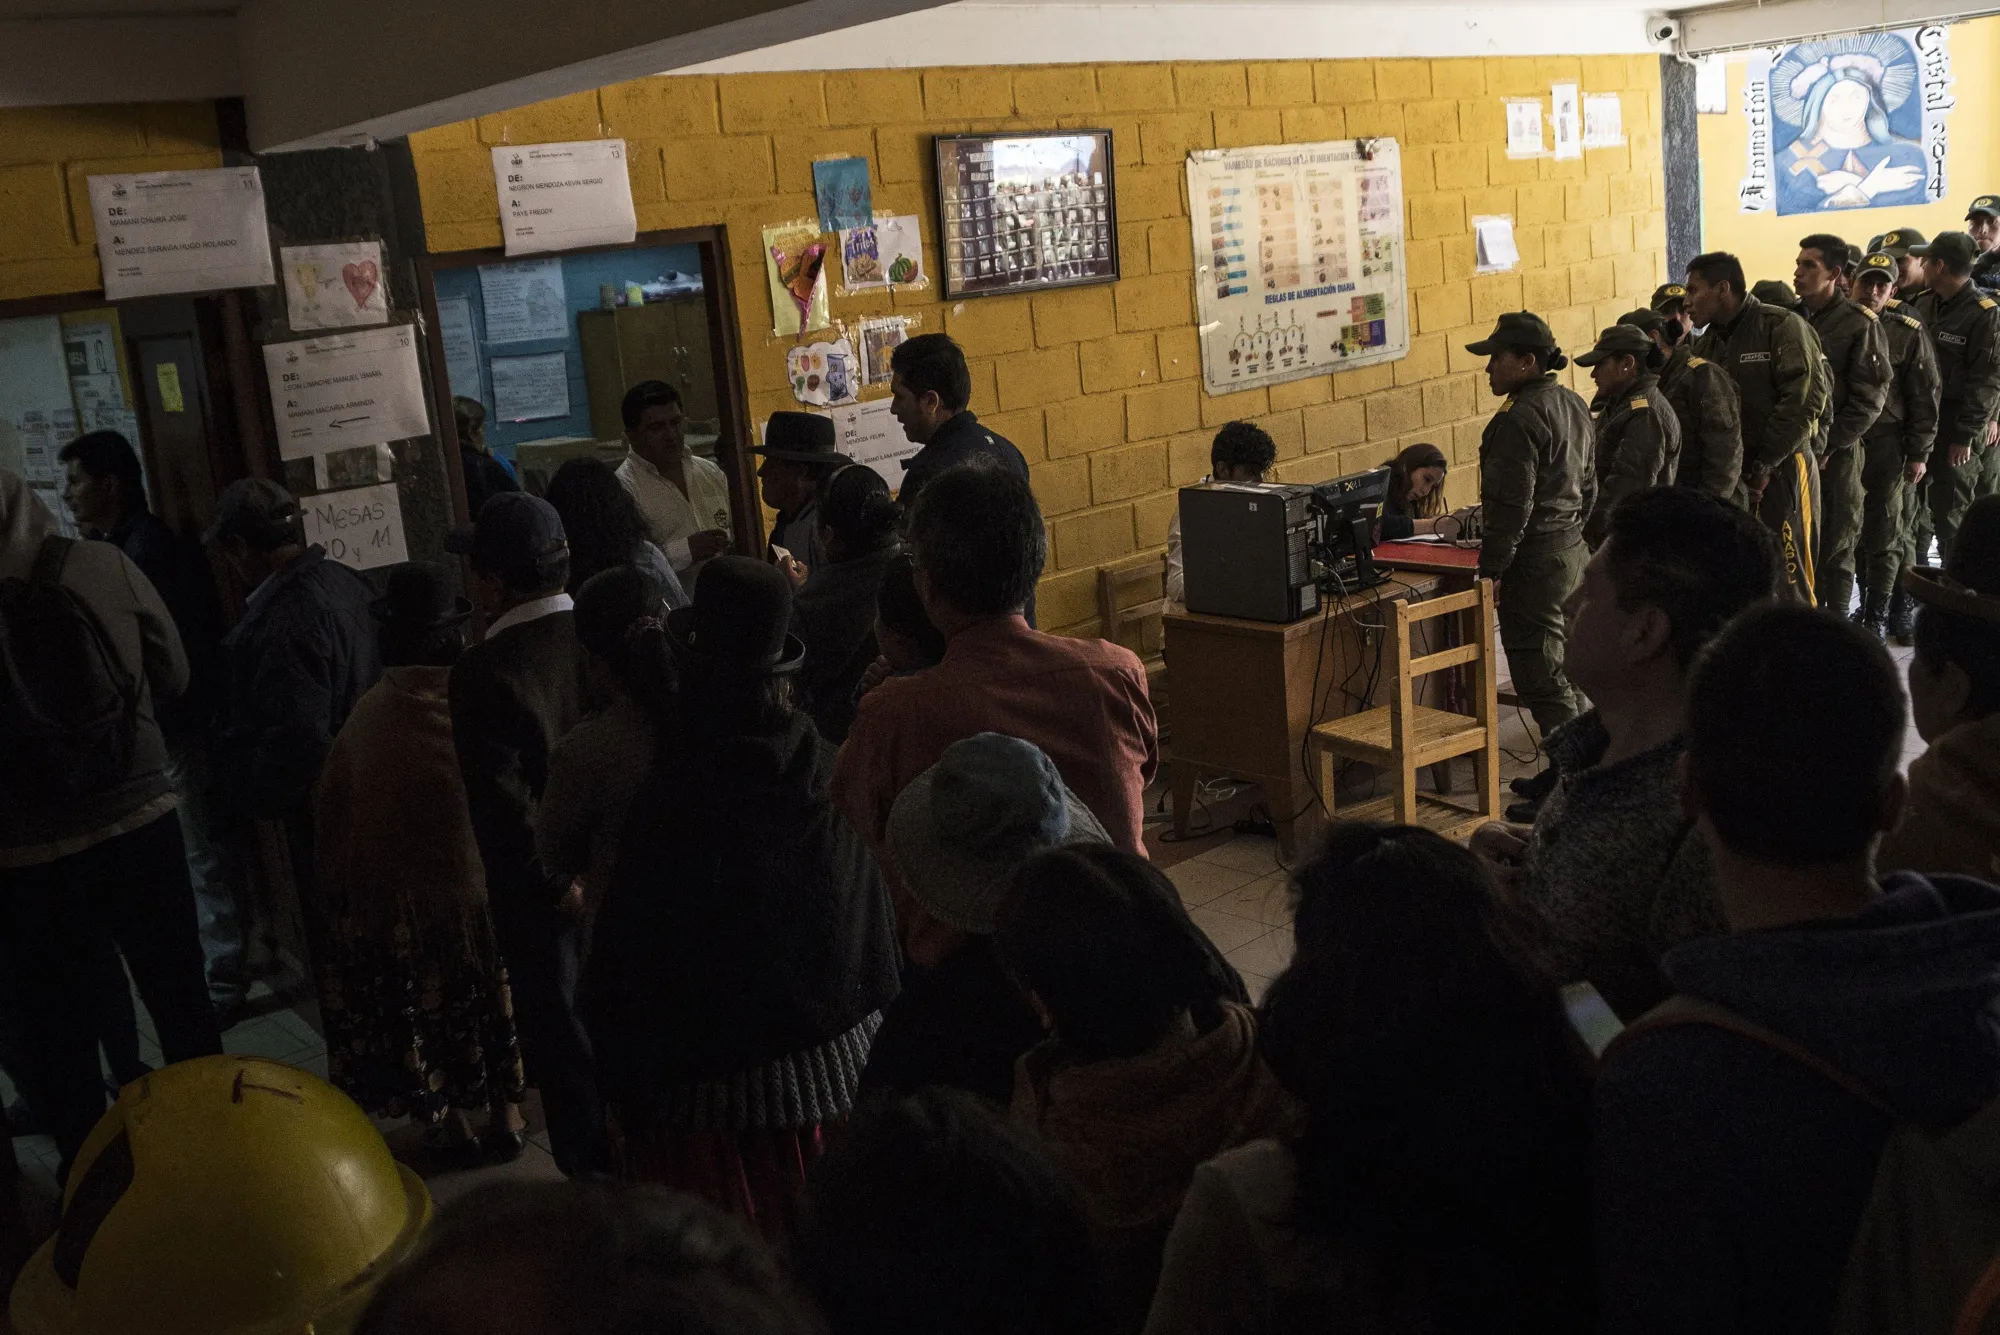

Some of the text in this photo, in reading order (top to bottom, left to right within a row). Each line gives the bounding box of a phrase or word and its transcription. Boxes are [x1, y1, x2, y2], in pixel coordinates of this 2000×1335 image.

[1915, 25, 1956, 199] Cristal 2014
[611, 150, 620, 159] 13
[508, 174, 523, 183] DE:
[242, 180, 254, 189] 11
[508, 177, 603, 192] NEGRON MENDOZA KEVIN SERGIO
[108, 207, 127, 217] DE:
[529, 207, 553, 216] FREDDY
[109, 218, 140, 226] MAMANI
[168, 214, 187, 222] JOSE
[113, 236, 124, 245] A:
[114, 247, 146, 256] MENDEZ
[180, 242, 200, 250] HUGO
[202, 239, 237, 249] ROLANDO
[1265, 293, 1287, 304] REGLAS
[1287, 291, 1295, 301] DE
[1337, 282, 1355, 293] DIARIA
[399, 338, 410, 346] 10
[282, 372, 299, 382] DE:
[283, 384, 302, 392] LEON
[333, 374, 359, 383] MANUEL
[359, 370, 383, 379] ISMAEL
[286, 400, 298, 408] A:
[845, 429, 857, 438] DE:
[848, 451, 856, 459] A:
[316, 502, 385, 534] MESAS
[371, 525, 391, 548] 11
[1782, 520, 1797, 584] ANAPOL
